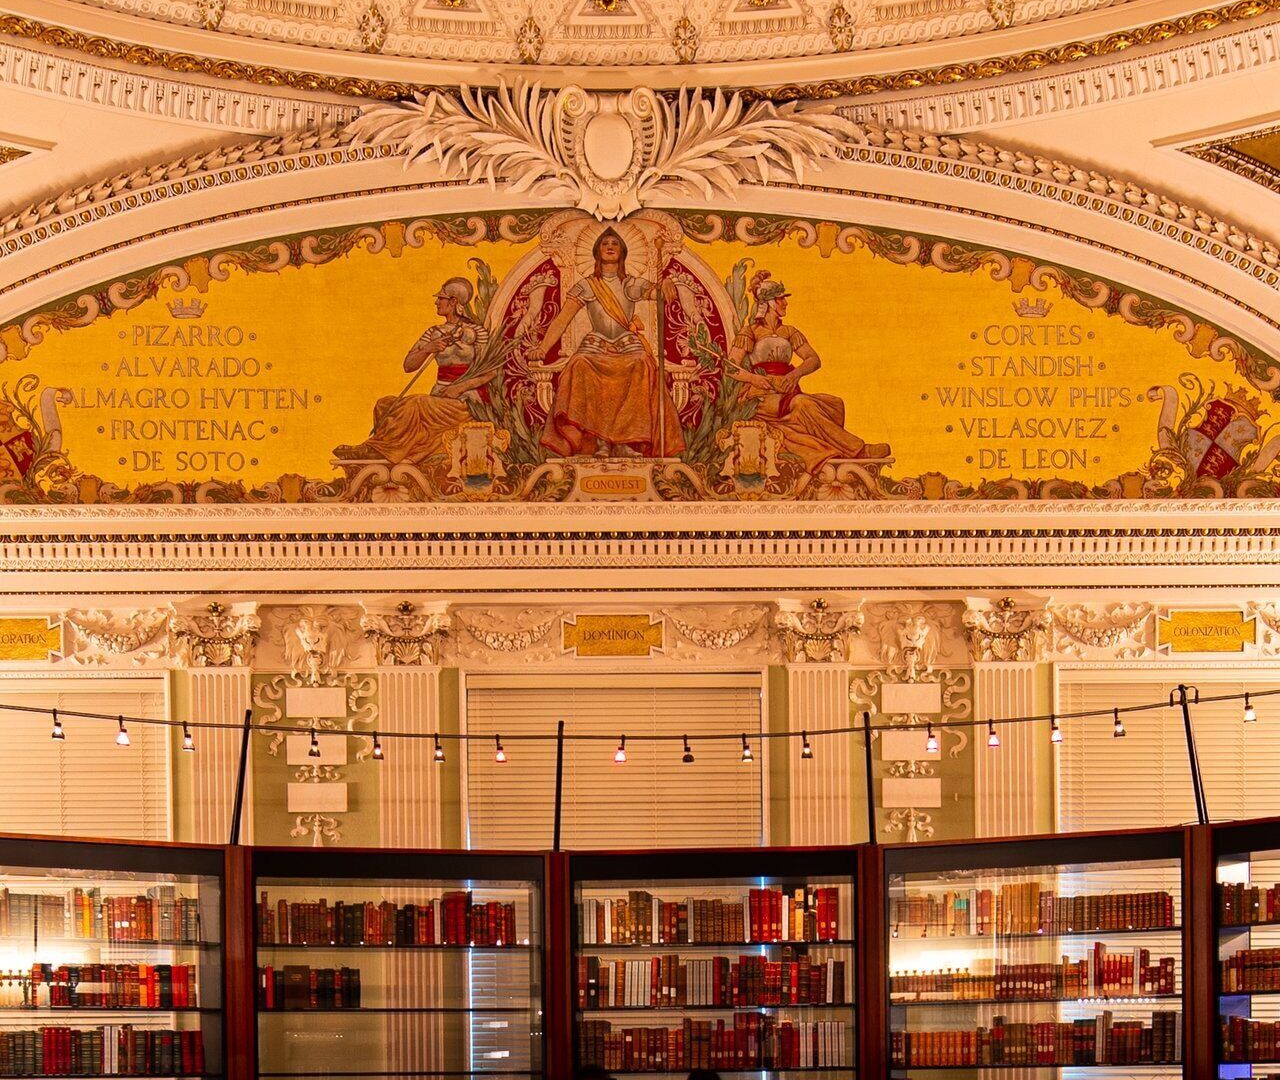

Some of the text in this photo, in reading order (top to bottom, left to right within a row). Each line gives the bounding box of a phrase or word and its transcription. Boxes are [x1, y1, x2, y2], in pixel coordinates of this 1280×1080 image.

[131, 325, 244, 347] PIZARRO
[983, 324, 1083, 346] CORTES
[114, 356, 261, 378] ALVARADO
[970, 355, 1094, 377] STANDISH
[200, 388, 309, 410] HVTTEN
[935, 386, 1132, 408] WINSLOW PHIPS
[110, 419, 266, 441] FRONTENAC
[959, 418, 1108, 439] VELASQVEZ
[132, 450, 246, 472] DE SOTO
[978, 448, 1088, 470] DE LEON
[585, 479, 641, 490] CONQVEST
[583, 629, 645, 641] DOMINION
[1173, 625, 1241, 637] COLONIZATION
